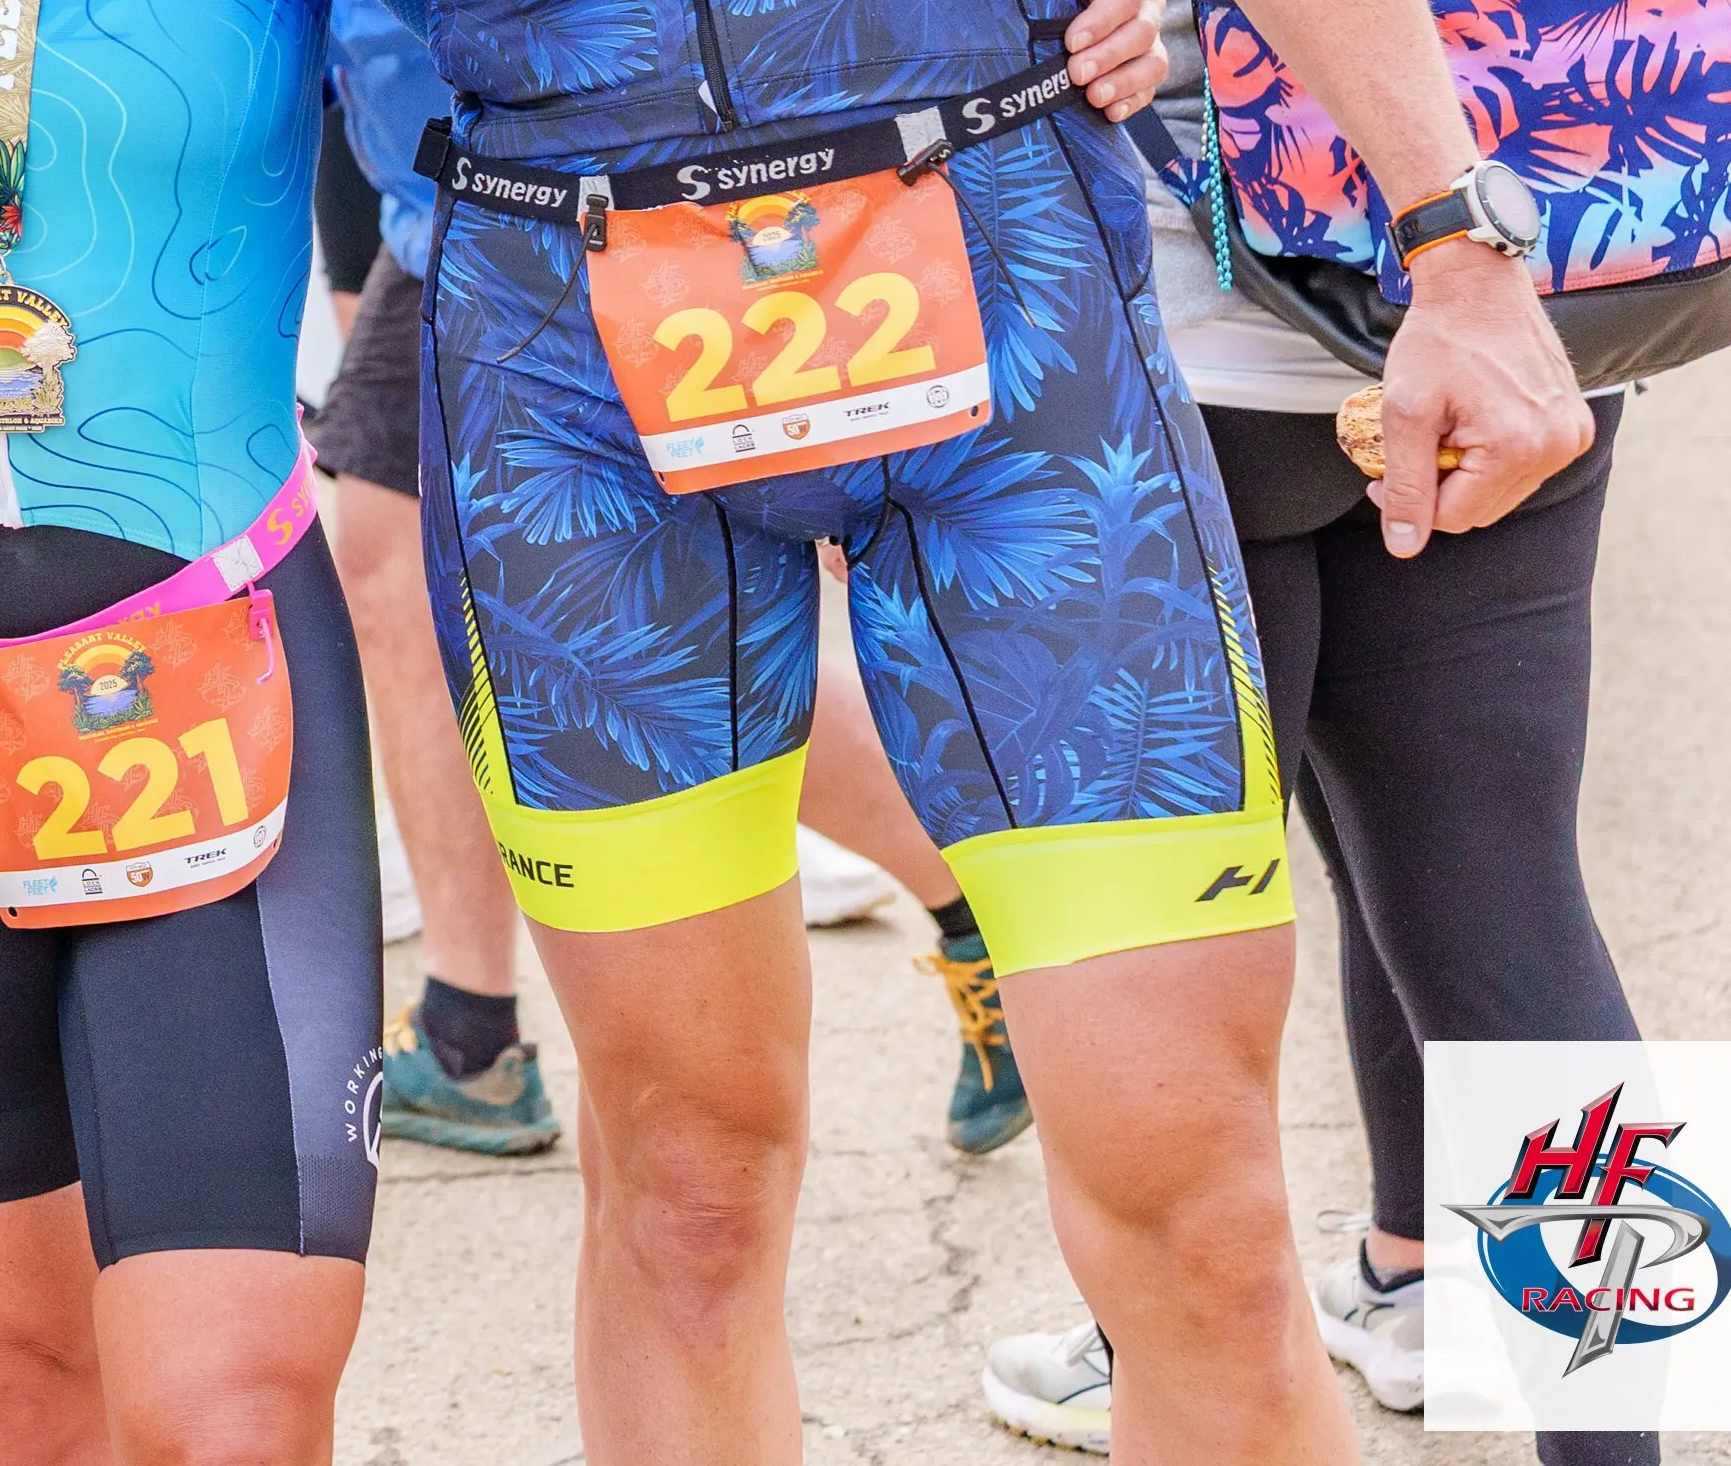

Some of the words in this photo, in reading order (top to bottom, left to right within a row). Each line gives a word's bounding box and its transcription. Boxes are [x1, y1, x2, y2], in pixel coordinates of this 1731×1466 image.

[999, 68, 1072, 119] synerg
[717, 146, 836, 192] synergy
[472, 170, 568, 208] synergy
[16, 291, 69, 328] VALLEY
[652, 272, 938, 423] 222
[843, 401, 890, 418] TREK
[57, 632, 103, 670] PLEASANT
[106, 631, 148, 653] VALLEY
[99, 679, 118, 691] 2025
[15, 718, 250, 860] 221
[184, 848, 228, 864] TREK
[497, 840, 575, 889] RANCE
[23, 877, 50, 889] FLEET
[344, 1045, 384, 1143] WORKING
